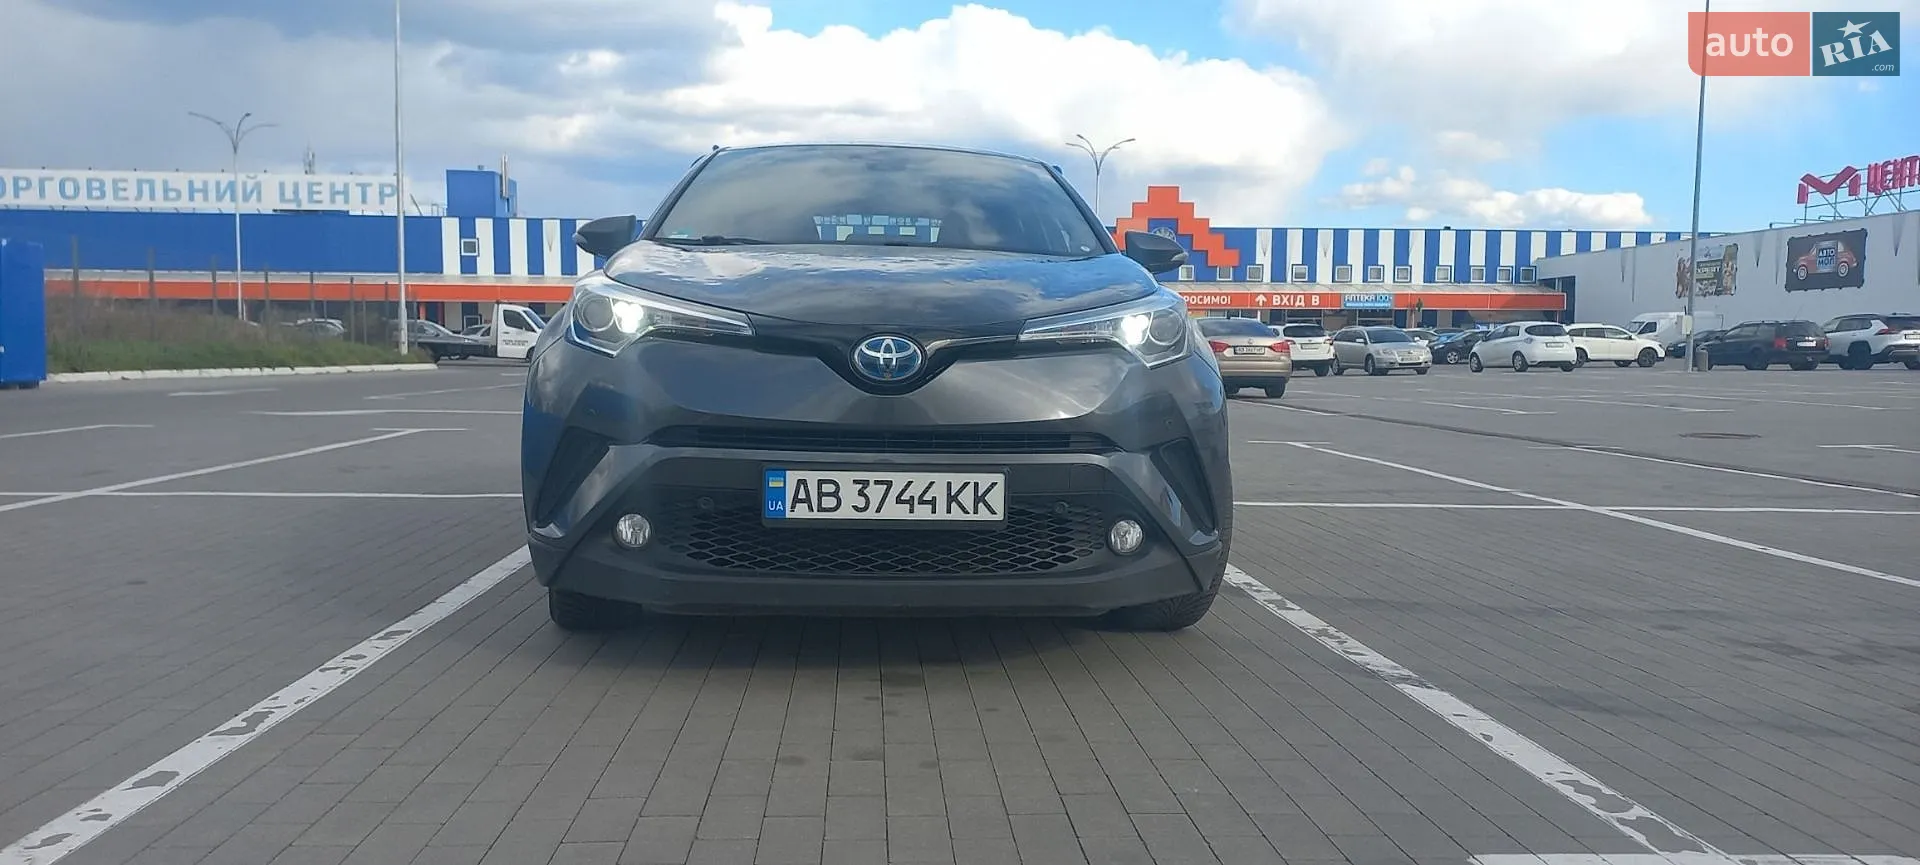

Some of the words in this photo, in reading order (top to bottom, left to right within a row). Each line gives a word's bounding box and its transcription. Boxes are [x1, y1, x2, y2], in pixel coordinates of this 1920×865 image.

[1867, 155, 1920, 195] ЦЕНТ
[278, 180, 397, 207] ЦЕНТР
[1272, 295, 1305, 307] ВХІД
[768, 501, 783, 511] UA
[789, 479, 842, 512] AB
[851, 479, 937, 514] 3744
[946, 481, 998, 515] KK
